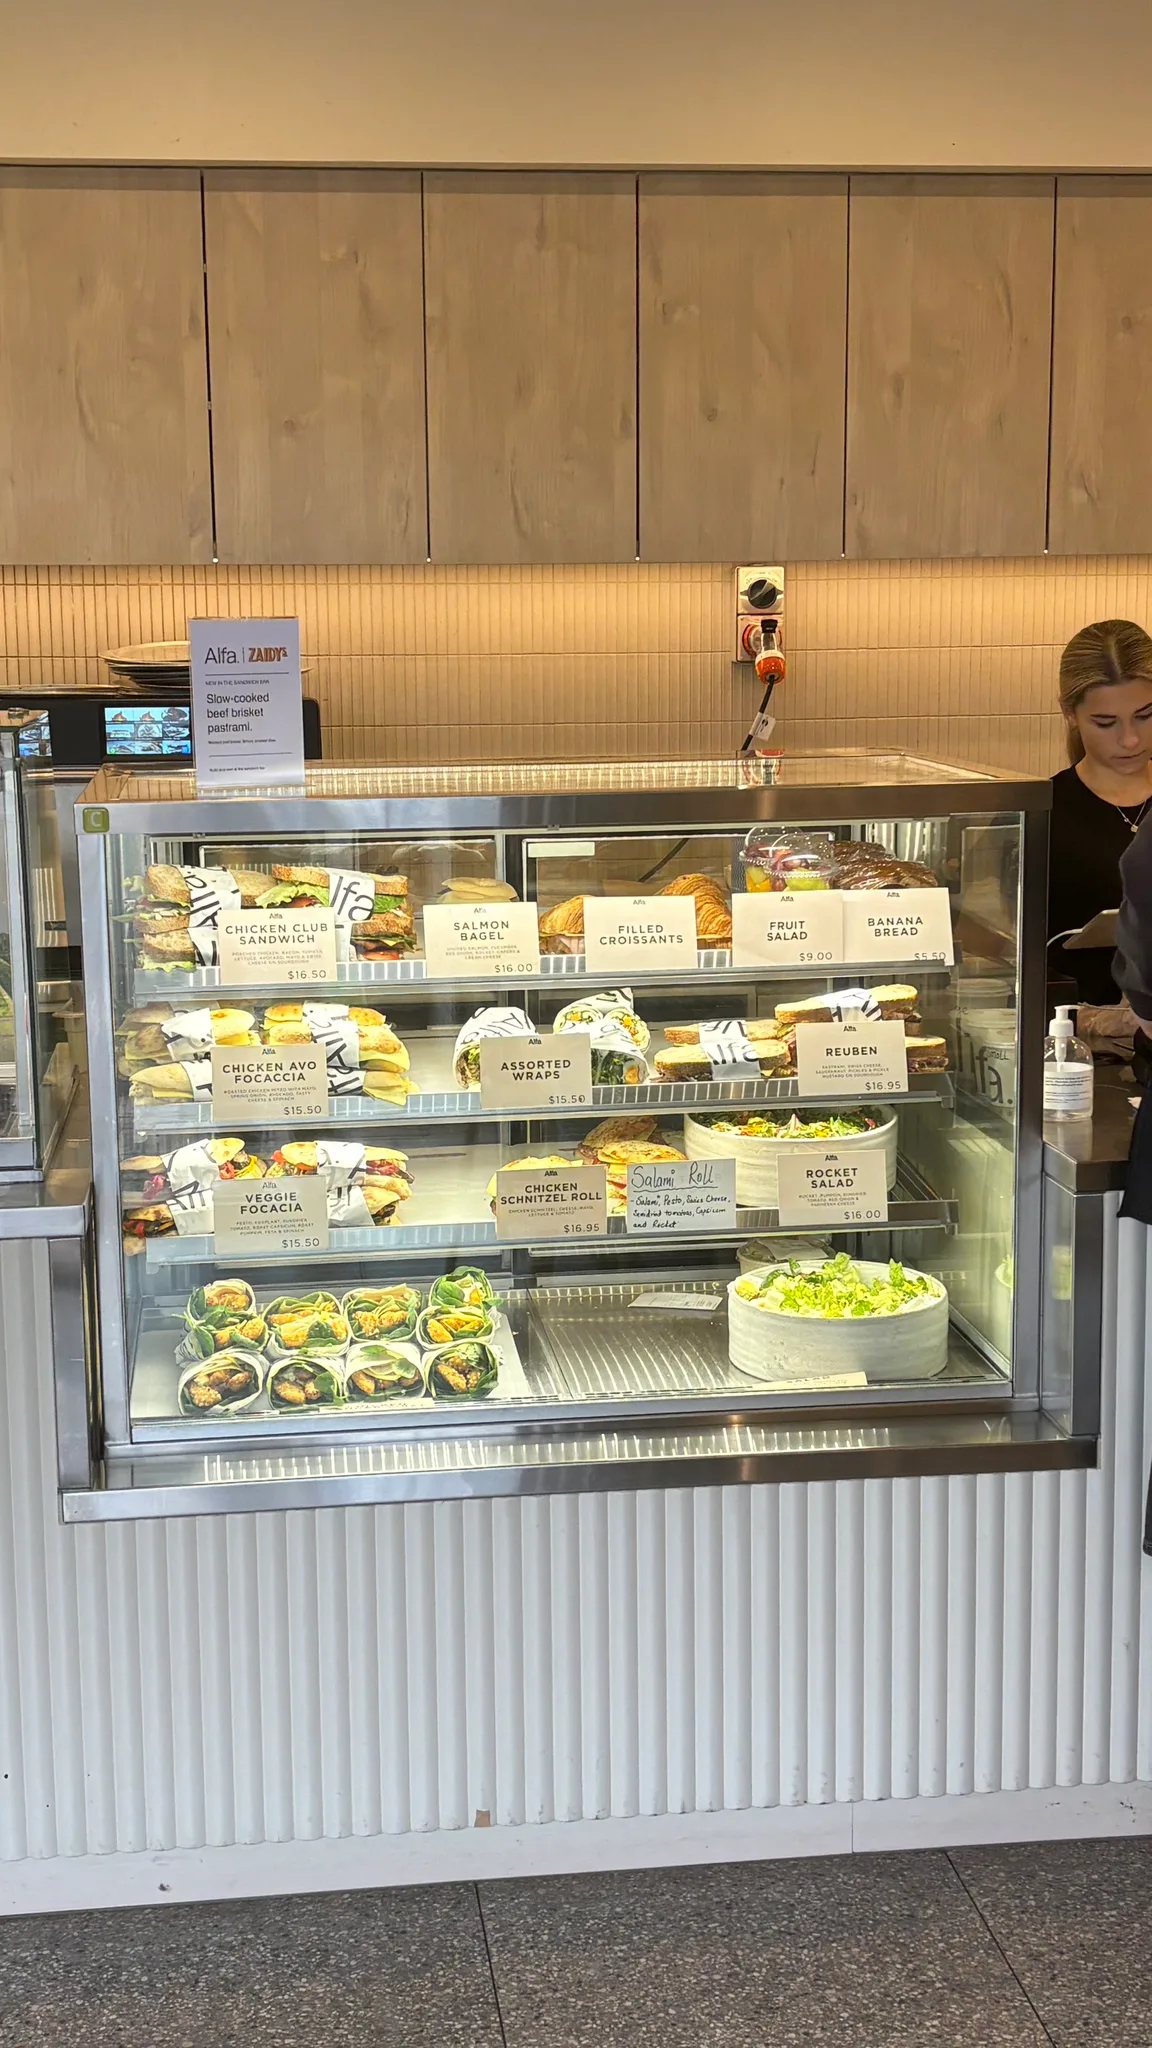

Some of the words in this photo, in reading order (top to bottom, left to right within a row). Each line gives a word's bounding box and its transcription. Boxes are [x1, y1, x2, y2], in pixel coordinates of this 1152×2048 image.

[205, 647, 240, 664] Alfa.
[207, 693, 269, 704] Slow-cooked
[207, 709, 229, 718] beef
[231, 708, 263, 718] brisket
[207, 721, 252, 735] pastrami.
[454, 921, 509, 930] SALMON
[769, 921, 805, 930] FRUIT
[868, 916, 923, 927] BANANA
[225, 925, 287, 934] CHICKEN
[293, 923, 328, 932] CLUB
[618, 925, 664, 934] FILLED
[874, 927, 918, 937] BREAD
[239, 935, 315, 945] SANDWICH
[460, 932, 504, 941] BAGEL
[600, 935, 683, 945] CROISSANTS
[767, 932, 808, 941] SALAD
[799, 952, 832, 961] $9.00
[914, 952, 946, 961] $5.50
[494, 964, 533, 973] $16.00
[288, 970, 327, 980] $16.50
[826, 1046, 877, 1056] REUBEN
[222, 1063, 283, 1074] CHICKEN
[290, 1061, 317, 1070] AVO
[501, 1060, 571, 1071] ASSORTED
[235, 1072, 306, 1084] FOCACCIA
[513, 1071, 560, 1080] WRAPS
[865, 1081, 901, 1091] $16.95
[548, 1095, 585, 1104] $15.50
[284, 1105, 322, 1115] $15.50
[631, 1166, 675, 1188] Salami
[689, 1161, 714, 1185] Roll
[806, 1168, 858, 1178] ROCKET
[525, 1183, 578, 1193] CHICKEN
[811, 1179, 854, 1188] SALAD
[245, 1192, 297, 1203] VEGGIE
[500, 1194, 567, 1205] SCHNITZEL
[571, 1192, 602, 1201] ROLL
[664, 1194, 685, 1206] Pesto,
[240, 1203, 303, 1214] FOCACIA
[844, 1210, 881, 1220] $16.00
[564, 1224, 600, 1233] $16.95
[652, 1220, 677, 1228] Rocket
[282, 1238, 320, 1248] $15.50
